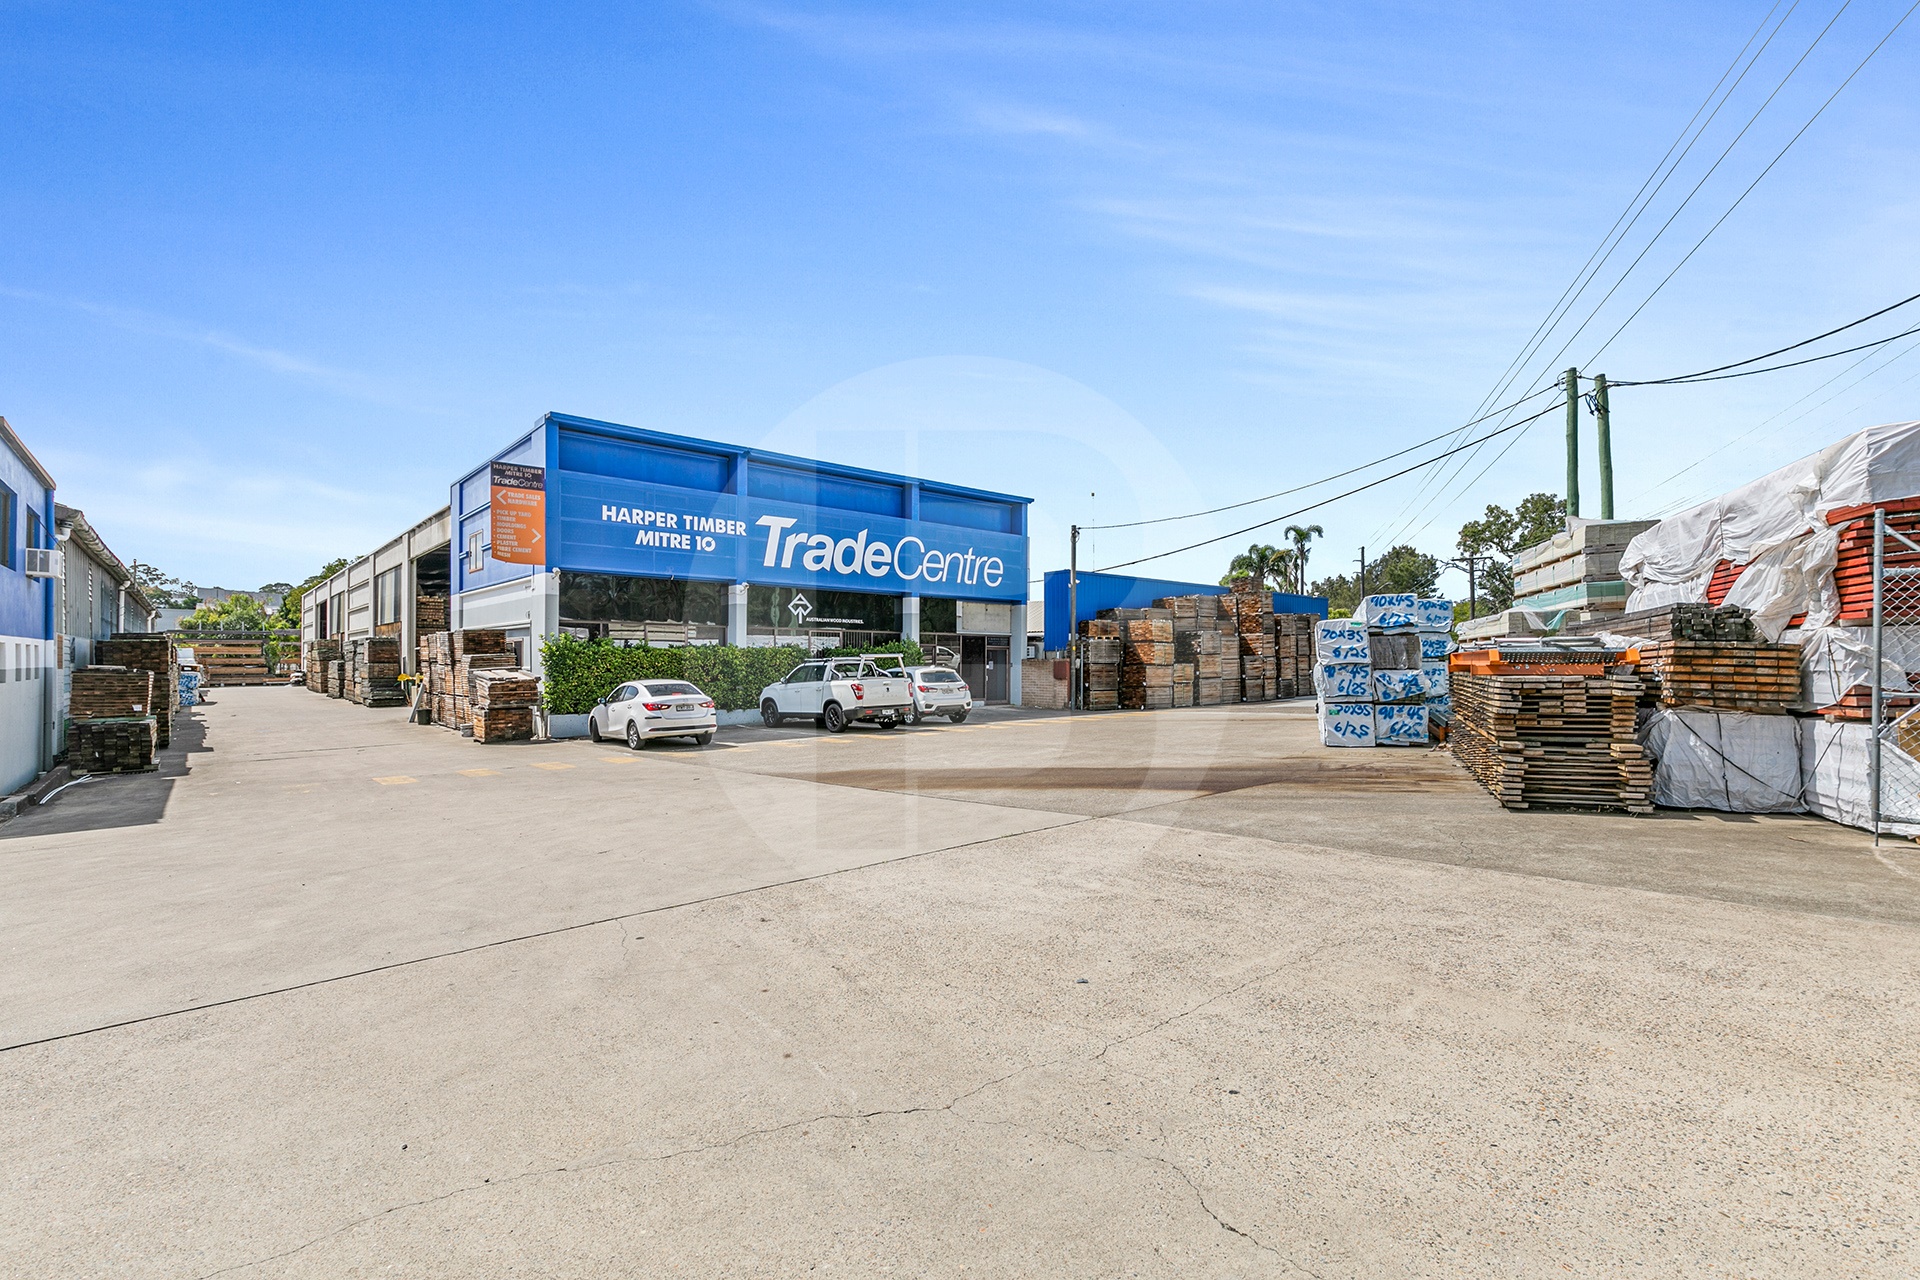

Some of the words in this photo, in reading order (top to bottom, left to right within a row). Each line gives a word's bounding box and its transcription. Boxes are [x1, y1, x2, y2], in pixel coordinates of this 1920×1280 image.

[508, 498, 537, 507] HARDWARE
[601, 504, 678, 528] HARPER
[683, 514, 747, 536] TIMBER
[635, 529, 691, 549] MITRE
[695, 535, 716, 552] 10
